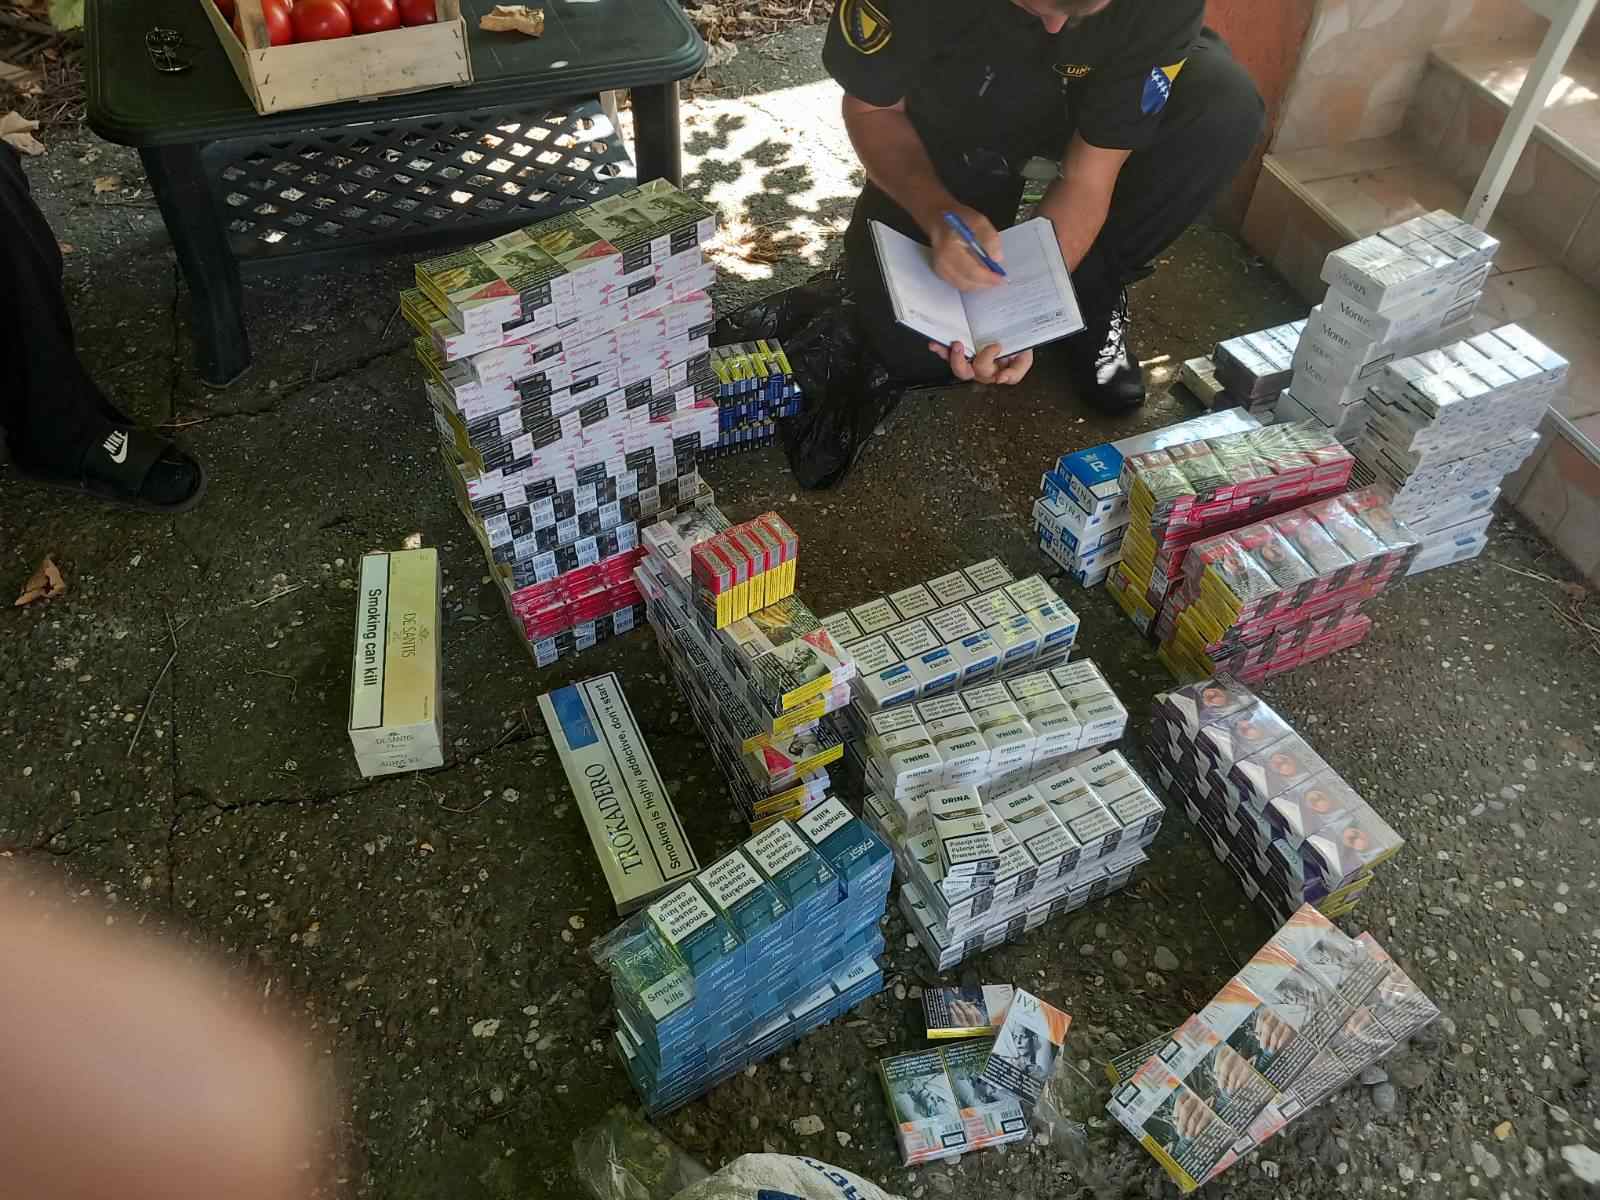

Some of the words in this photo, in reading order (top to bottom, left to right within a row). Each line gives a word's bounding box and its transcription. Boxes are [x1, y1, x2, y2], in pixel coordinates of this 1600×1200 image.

[1090, 460, 1106, 472] R
[362, 588, 382, 640] Smoking
[364, 642, 379, 665] can
[363, 668, 379, 687] kill
[594, 683, 609, 705] start
[604, 706, 622, 729] don't
[1041, 716, 1068, 727] DRINA
[995, 727, 1023, 739] DRINA
[617, 729, 642, 777] addictive,
[949, 739, 977, 751] DRINA
[903, 752, 930, 764] DRINA
[1091, 758, 1117, 774] DRINA
[1049, 775, 1076, 792] DRINA
[637, 778, 656, 810] highly
[941, 793, 971, 806] DRINA
[1008, 792, 1035, 809] DRINA
[584, 763, 643, 876] TROKADERO
[810, 810, 847, 837] Smoking
[811, 807, 832, 823] kills
[656, 821, 681, 870] Smoking
[756, 827, 781, 847] cancer
[772, 831, 792, 847] fatal
[755, 840, 773, 857] lung
[766, 840, 794, 860] causes
[768, 844, 804, 870] Smoking
[849, 837, 875, 861] FAST
[709, 857, 736, 880] cancer
[724, 862, 746, 879] fatal
[708, 874, 726, 889] lung
[719, 871, 747, 892] causes
[721, 878, 757, 903] Smoking
[659, 890, 687, 912] cancer
[676, 894, 698, 911] fatal
[658, 906, 676, 923] lung
[669, 904, 699, 926] causes
[671, 910, 709, 937] Smoking
[647, 976, 683, 1003] Smokin
[664, 989, 685, 1007] kills
